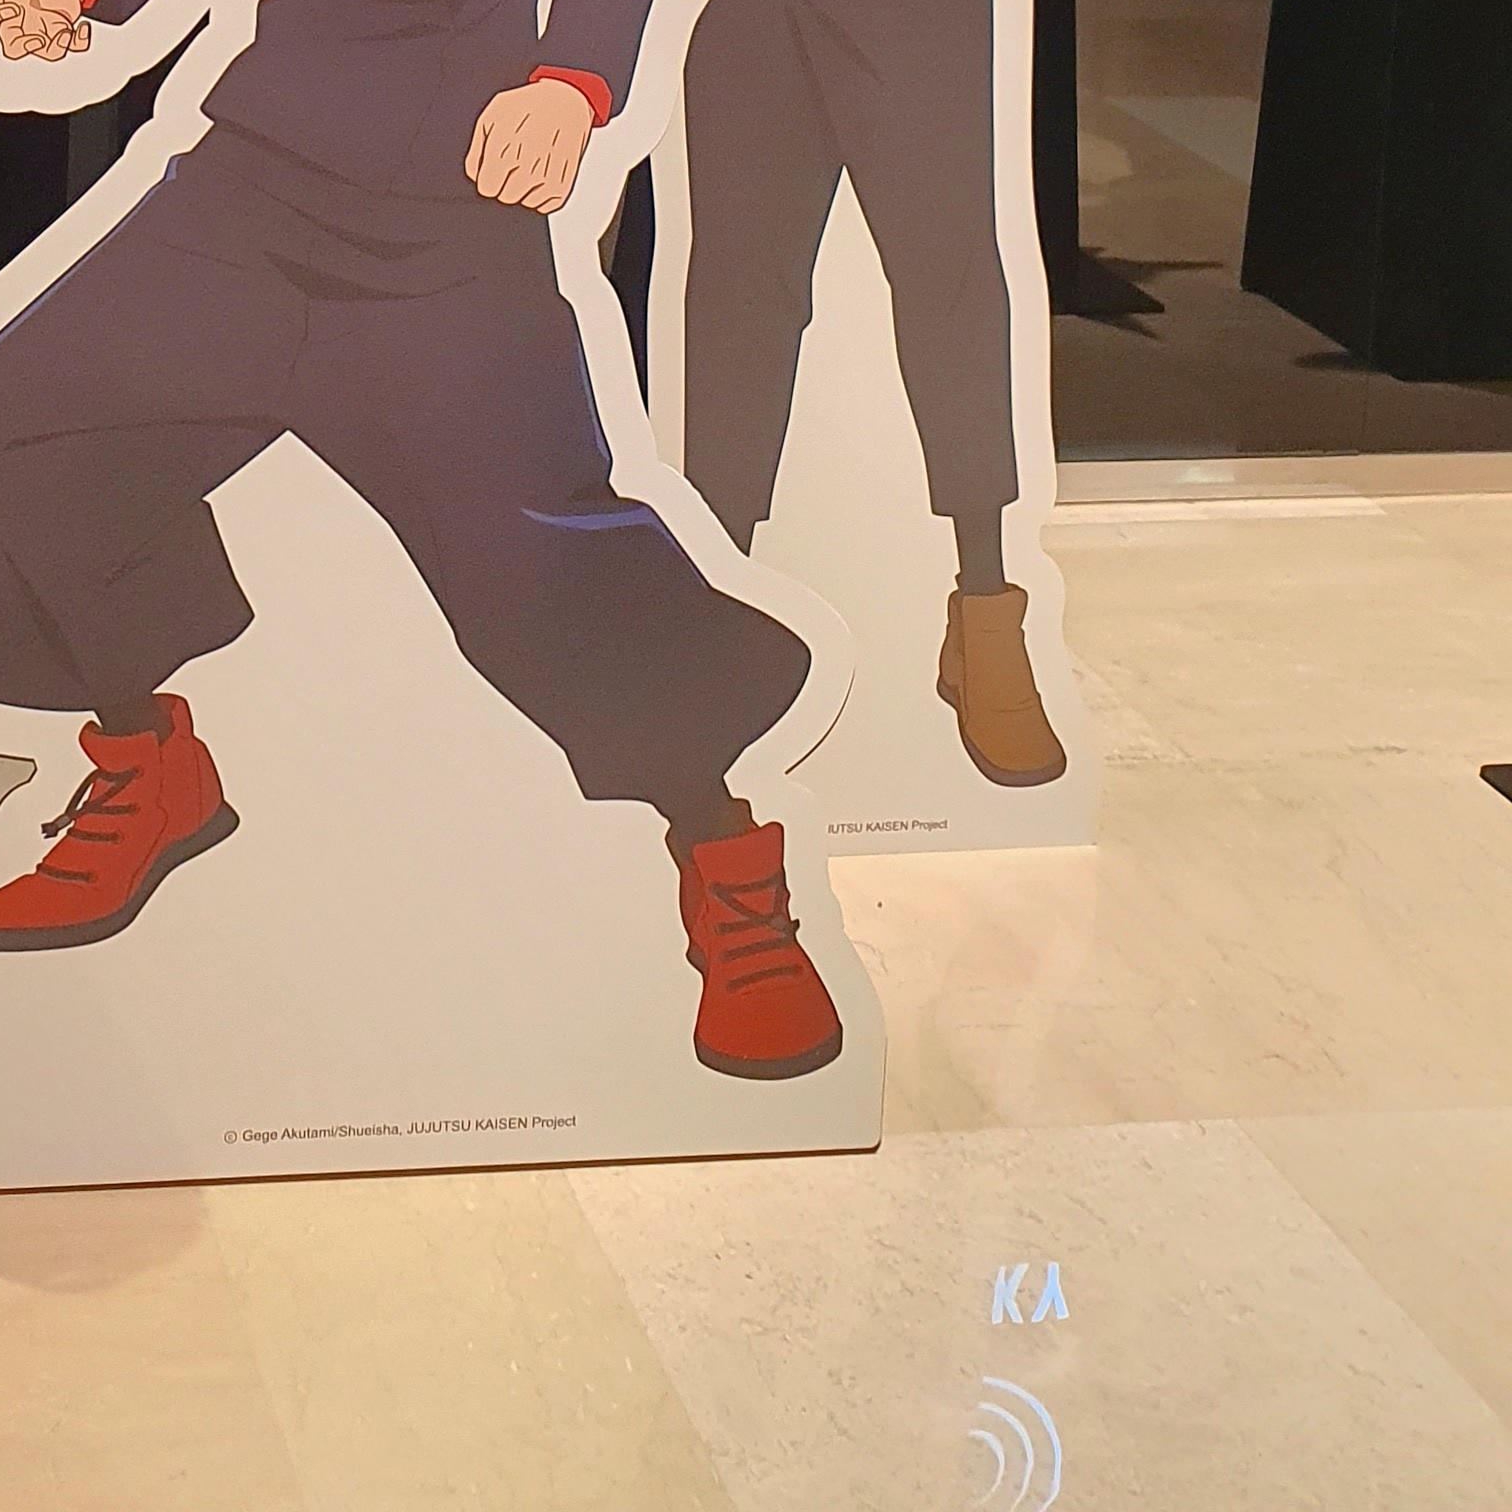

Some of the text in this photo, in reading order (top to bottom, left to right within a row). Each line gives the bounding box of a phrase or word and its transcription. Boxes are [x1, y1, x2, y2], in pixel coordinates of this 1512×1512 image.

[865, 819, 909, 833] KAISEN
[911, 819, 948, 832] Project
[241, 1129, 278, 1144] Gege
[280, 1122, 403, 1141] Akutami/Shueisha,
[406, 1119, 472, 1136] JUJUTSU
[474, 1116, 528, 1132] KAISEN
[531, 1114, 578, 1131] Project
